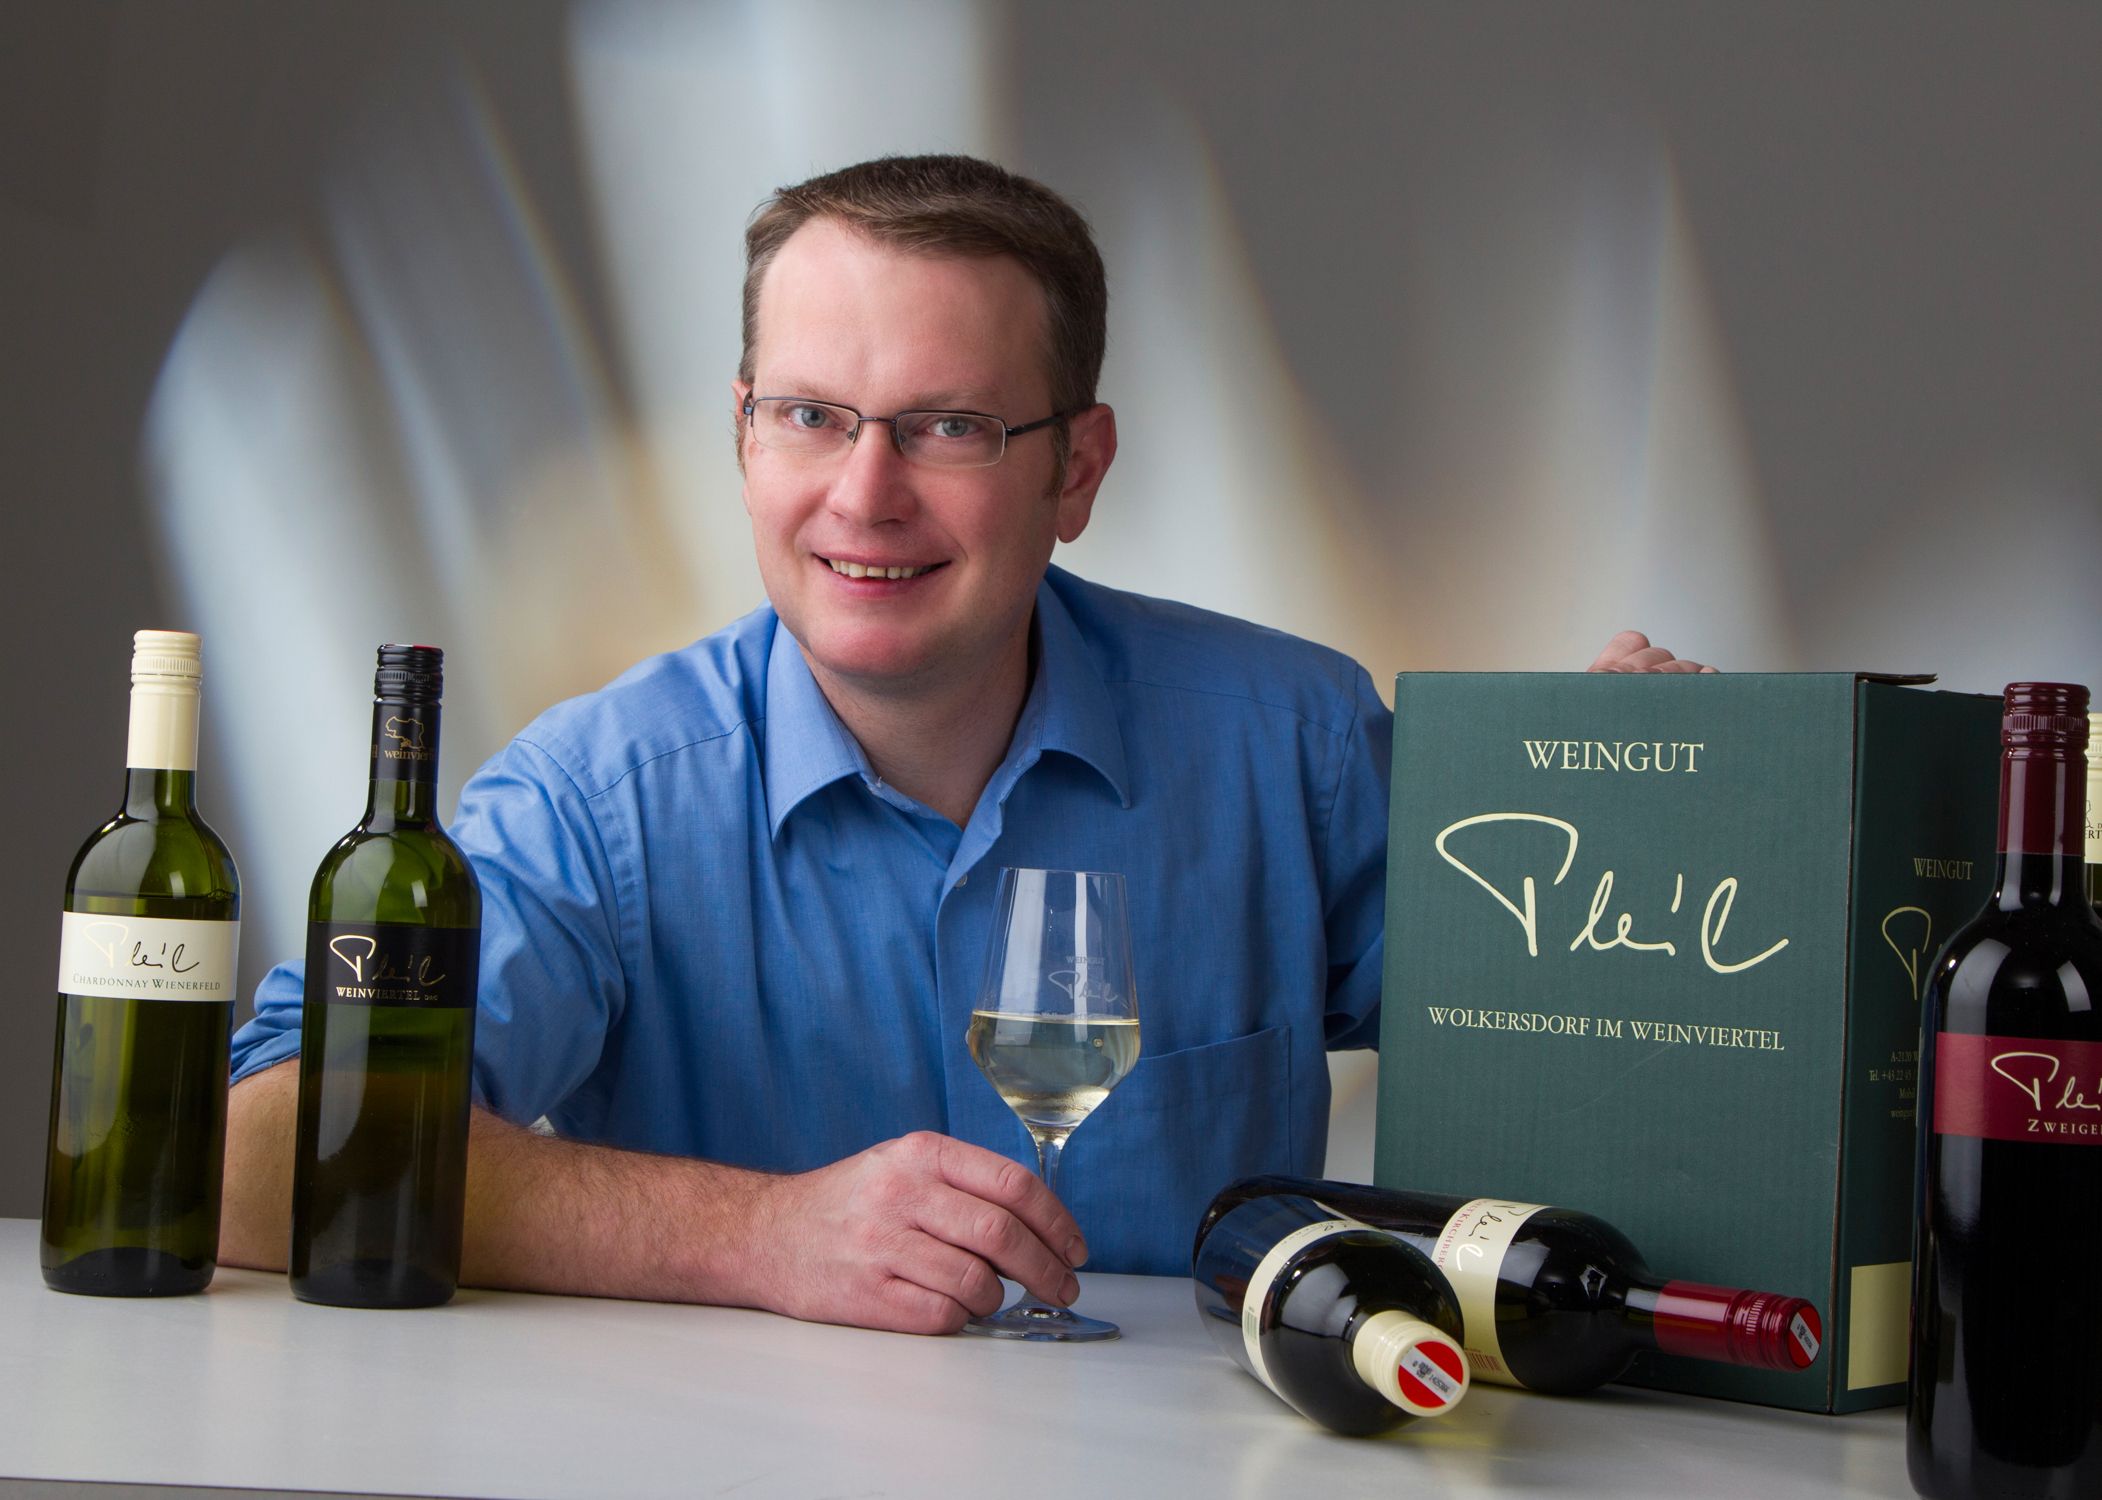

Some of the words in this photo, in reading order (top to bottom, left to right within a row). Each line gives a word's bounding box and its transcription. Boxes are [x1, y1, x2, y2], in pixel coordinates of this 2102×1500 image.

[1523, 740, 1704, 773] WEINGUT
[1914, 857, 1974, 881] WEINGUT
[73, 973, 149, 989] CHARDONNAY
[336, 986, 420, 1001] WEINVIERTEL
[1428, 1006, 1590, 1037] WOLKERSDORF
[1596, 1019, 1623, 1039] IM
[1630, 1021, 1785, 1051] WEINVIERTEL
[2028, 1119, 2102, 1135] ZWEIGE
